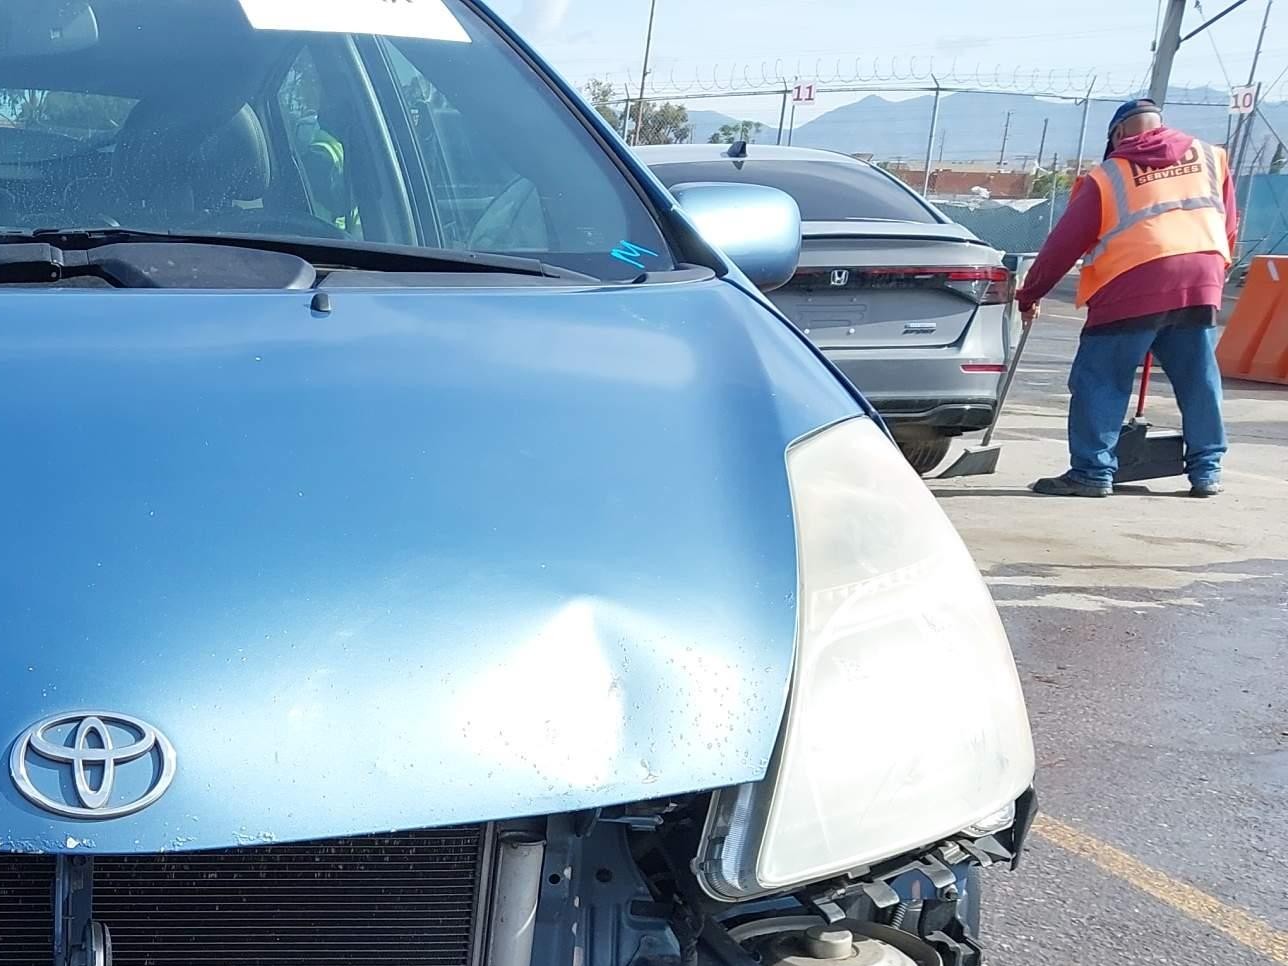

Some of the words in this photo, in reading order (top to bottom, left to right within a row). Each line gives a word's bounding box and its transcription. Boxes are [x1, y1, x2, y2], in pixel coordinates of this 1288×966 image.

[793, 84, 815, 101] 11
[1230, 92, 1253, 108] 10
[1137, 164, 1199, 185] SERVICES
